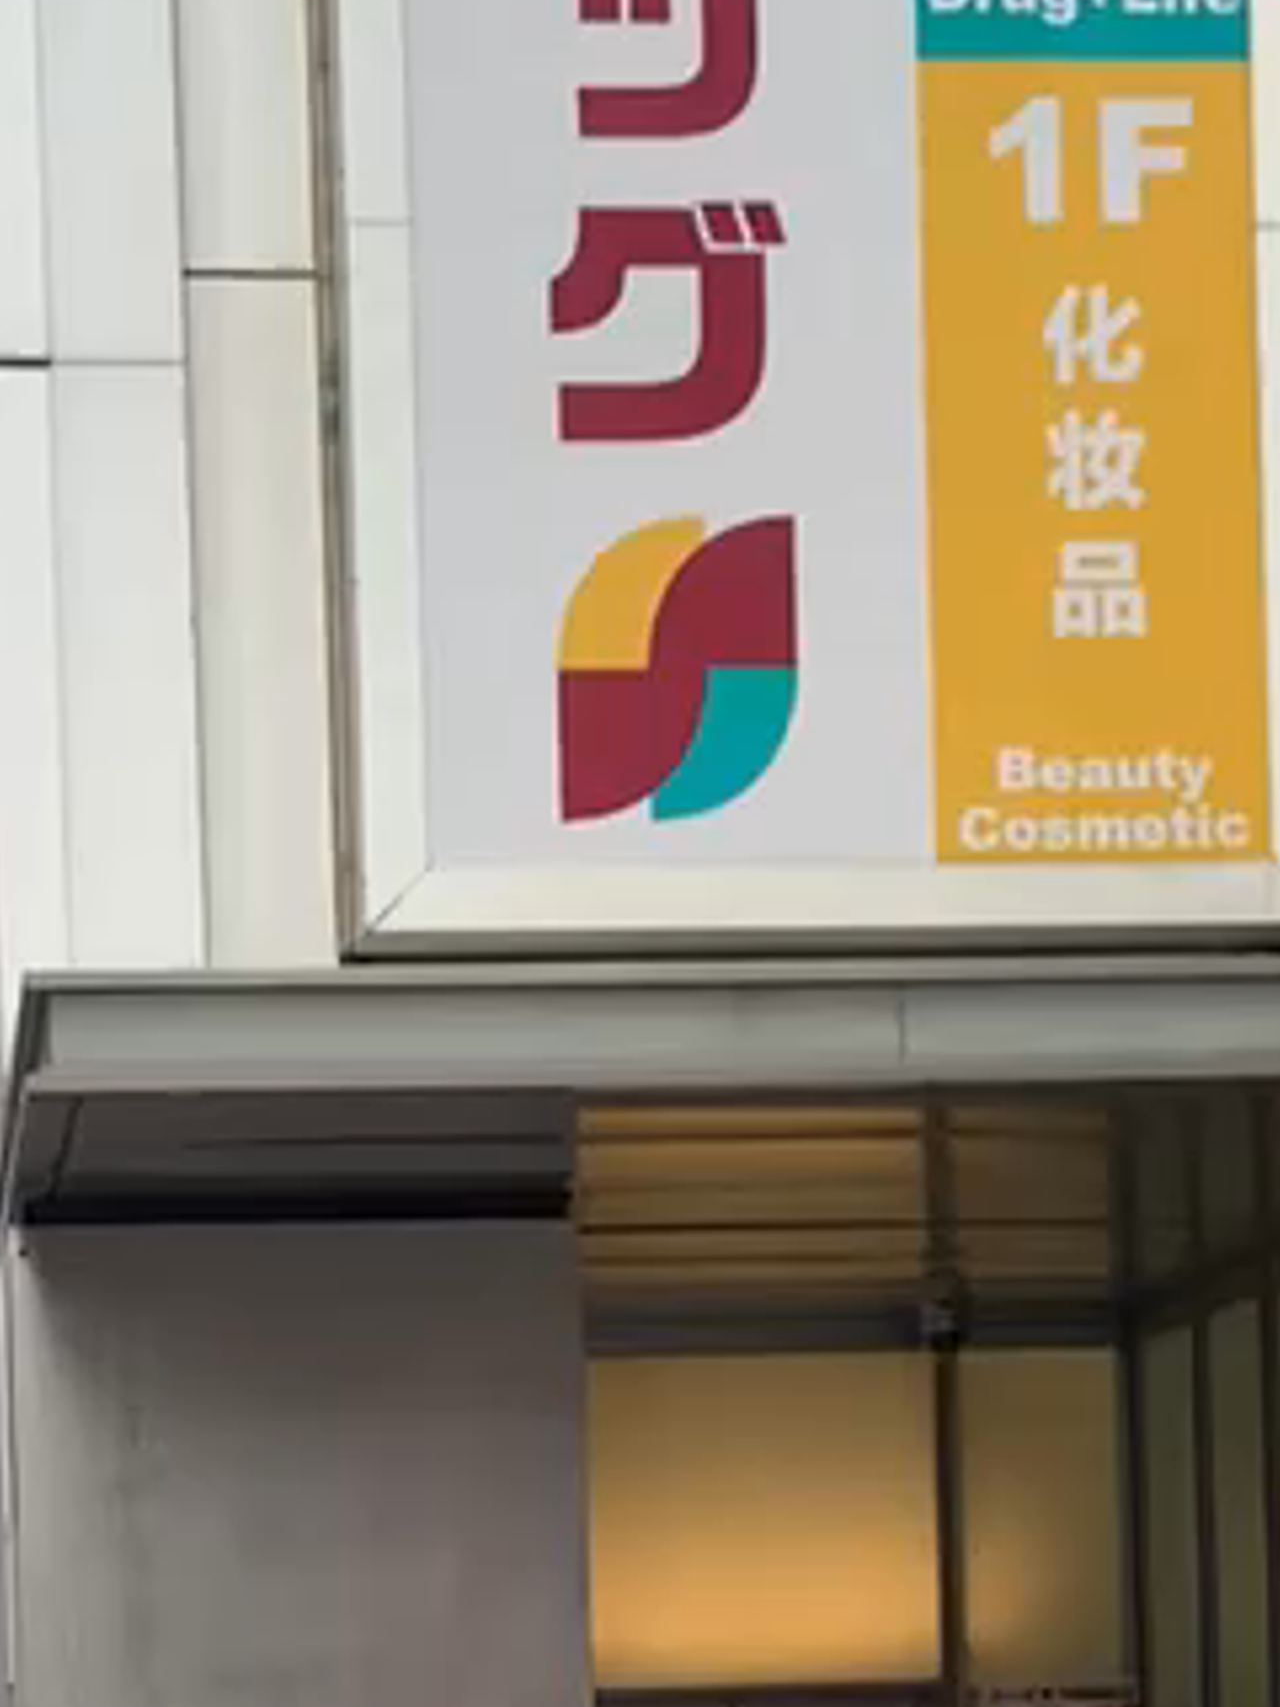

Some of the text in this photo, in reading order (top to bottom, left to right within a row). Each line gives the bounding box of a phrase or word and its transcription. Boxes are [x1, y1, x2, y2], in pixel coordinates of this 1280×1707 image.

[987, 94, 1194, 225] 1F
[1041, 283, 1149, 640] 化妆品
[996, 747, 1213, 800] Beauty
[958, 803, 1251, 852] Cosmetic
